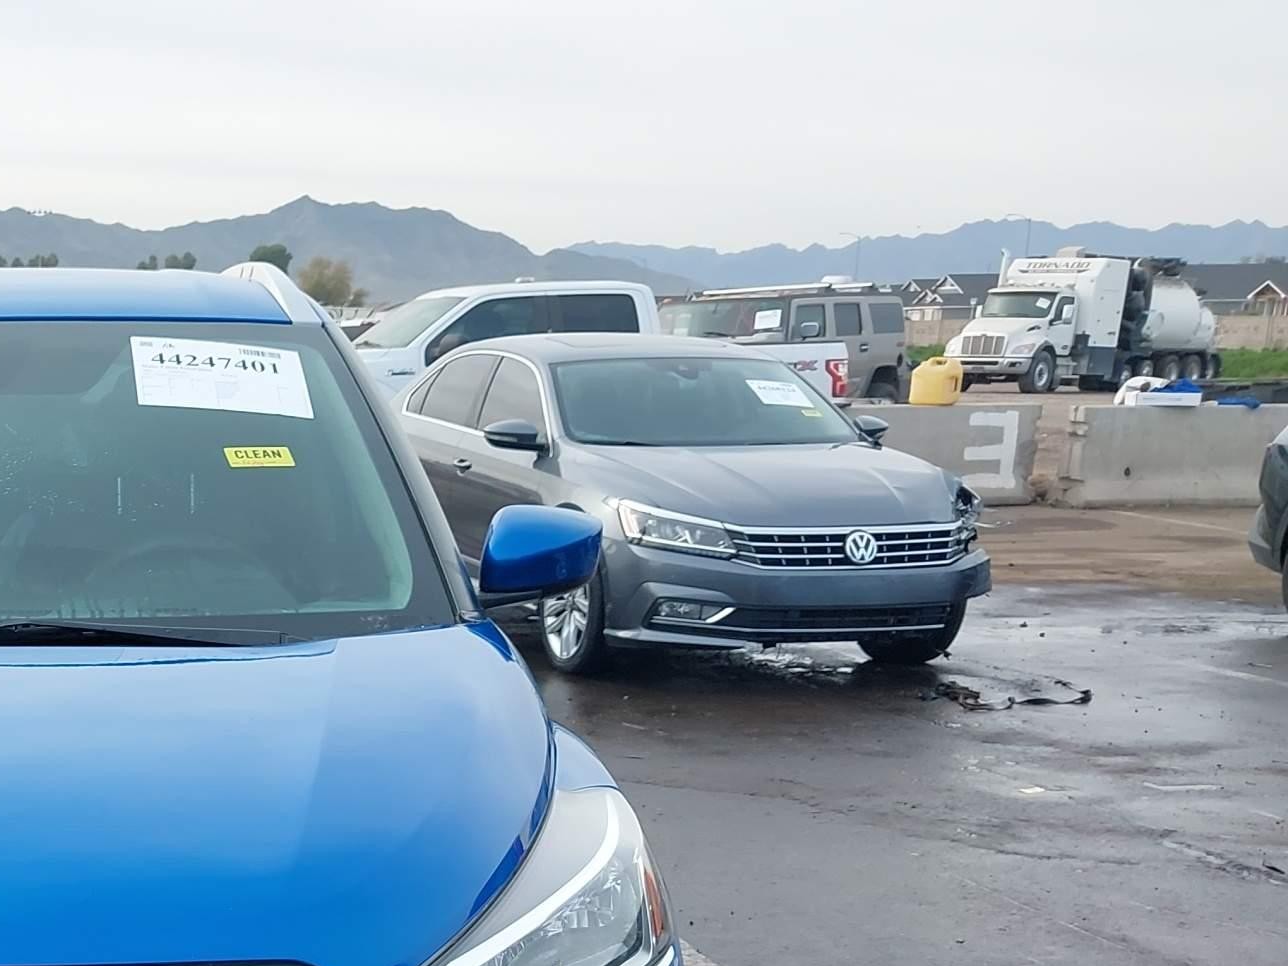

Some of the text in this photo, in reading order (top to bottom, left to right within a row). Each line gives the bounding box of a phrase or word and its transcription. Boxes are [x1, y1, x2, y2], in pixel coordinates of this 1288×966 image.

[1026, 261, 1091, 270] TORNADO
[150, 352, 281, 375] 44247401
[233, 449, 283, 460] CLEAN
